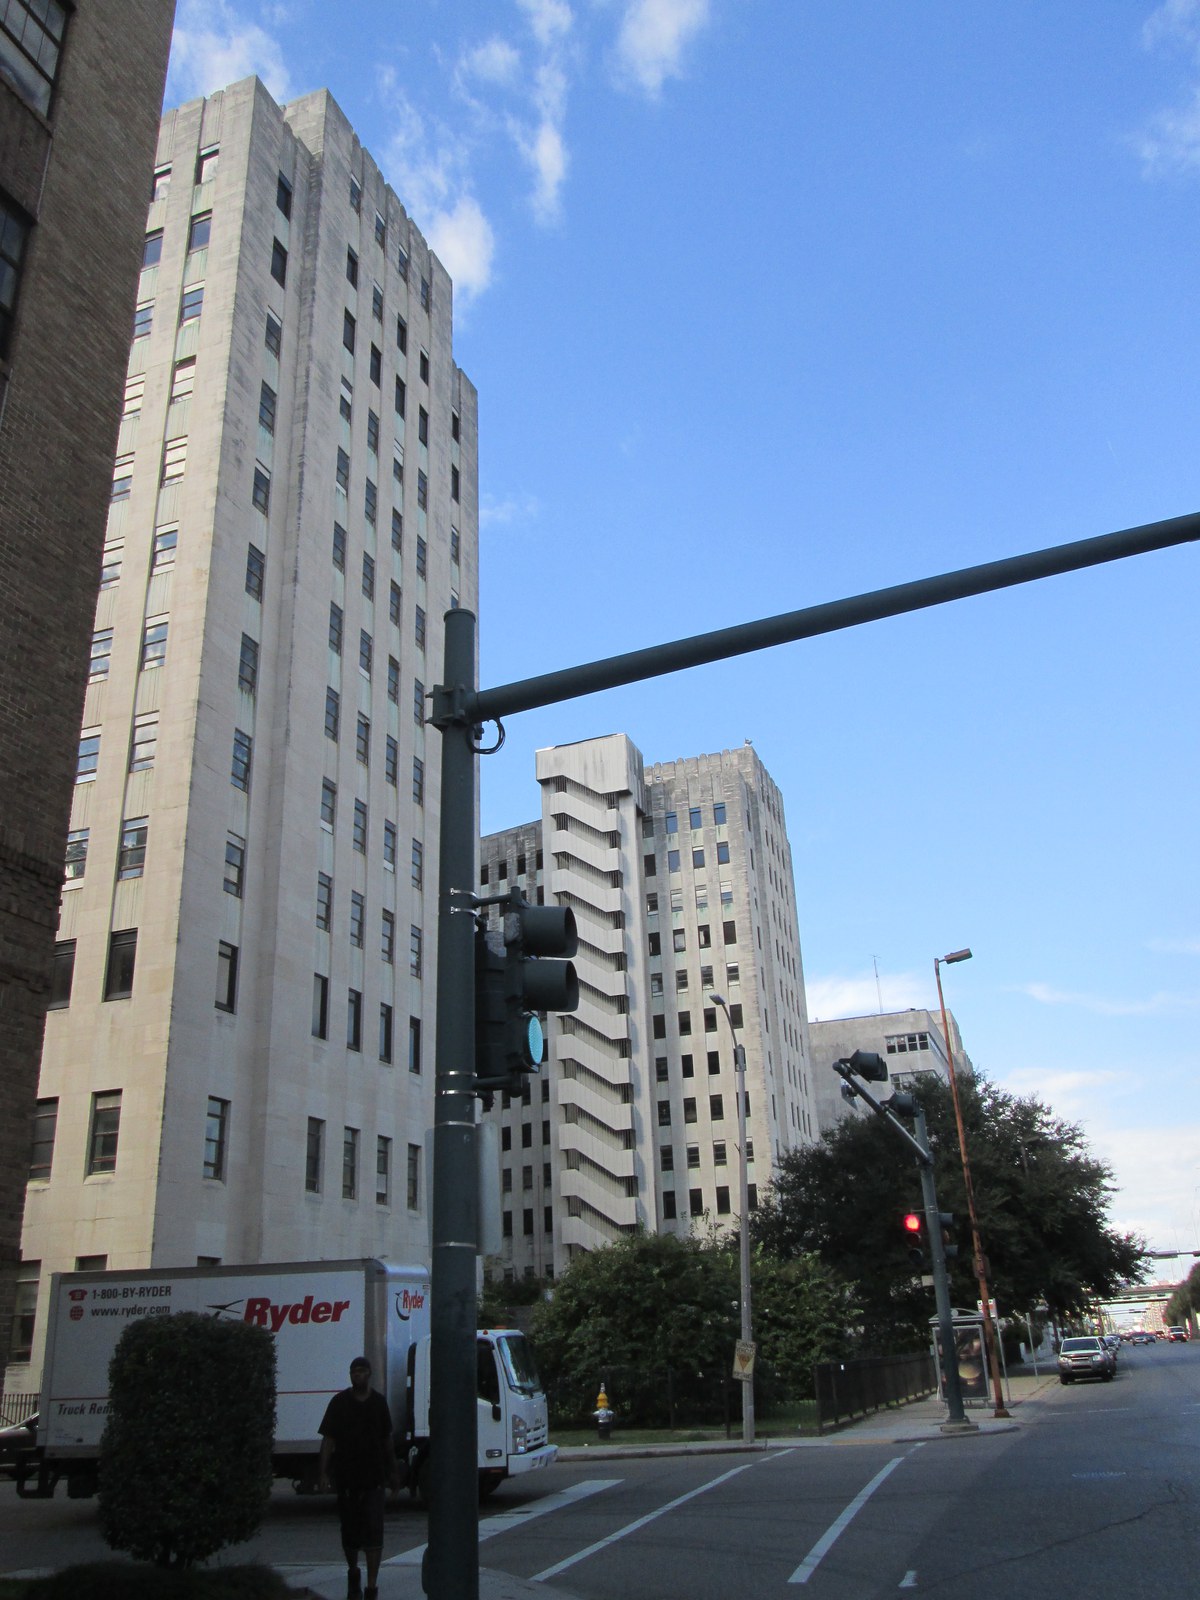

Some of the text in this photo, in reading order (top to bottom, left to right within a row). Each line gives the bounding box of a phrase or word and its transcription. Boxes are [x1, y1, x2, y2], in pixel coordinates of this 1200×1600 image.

[92, 1286, 172, 1300] 1-800-BY-RYDER
[403, 1289, 424, 1313] Ryder
[91, 1304, 171, 1318] www.ryder.com
[244, 1295, 350, 1333] Ryder
[58, 1403, 86, 1416] Truck
